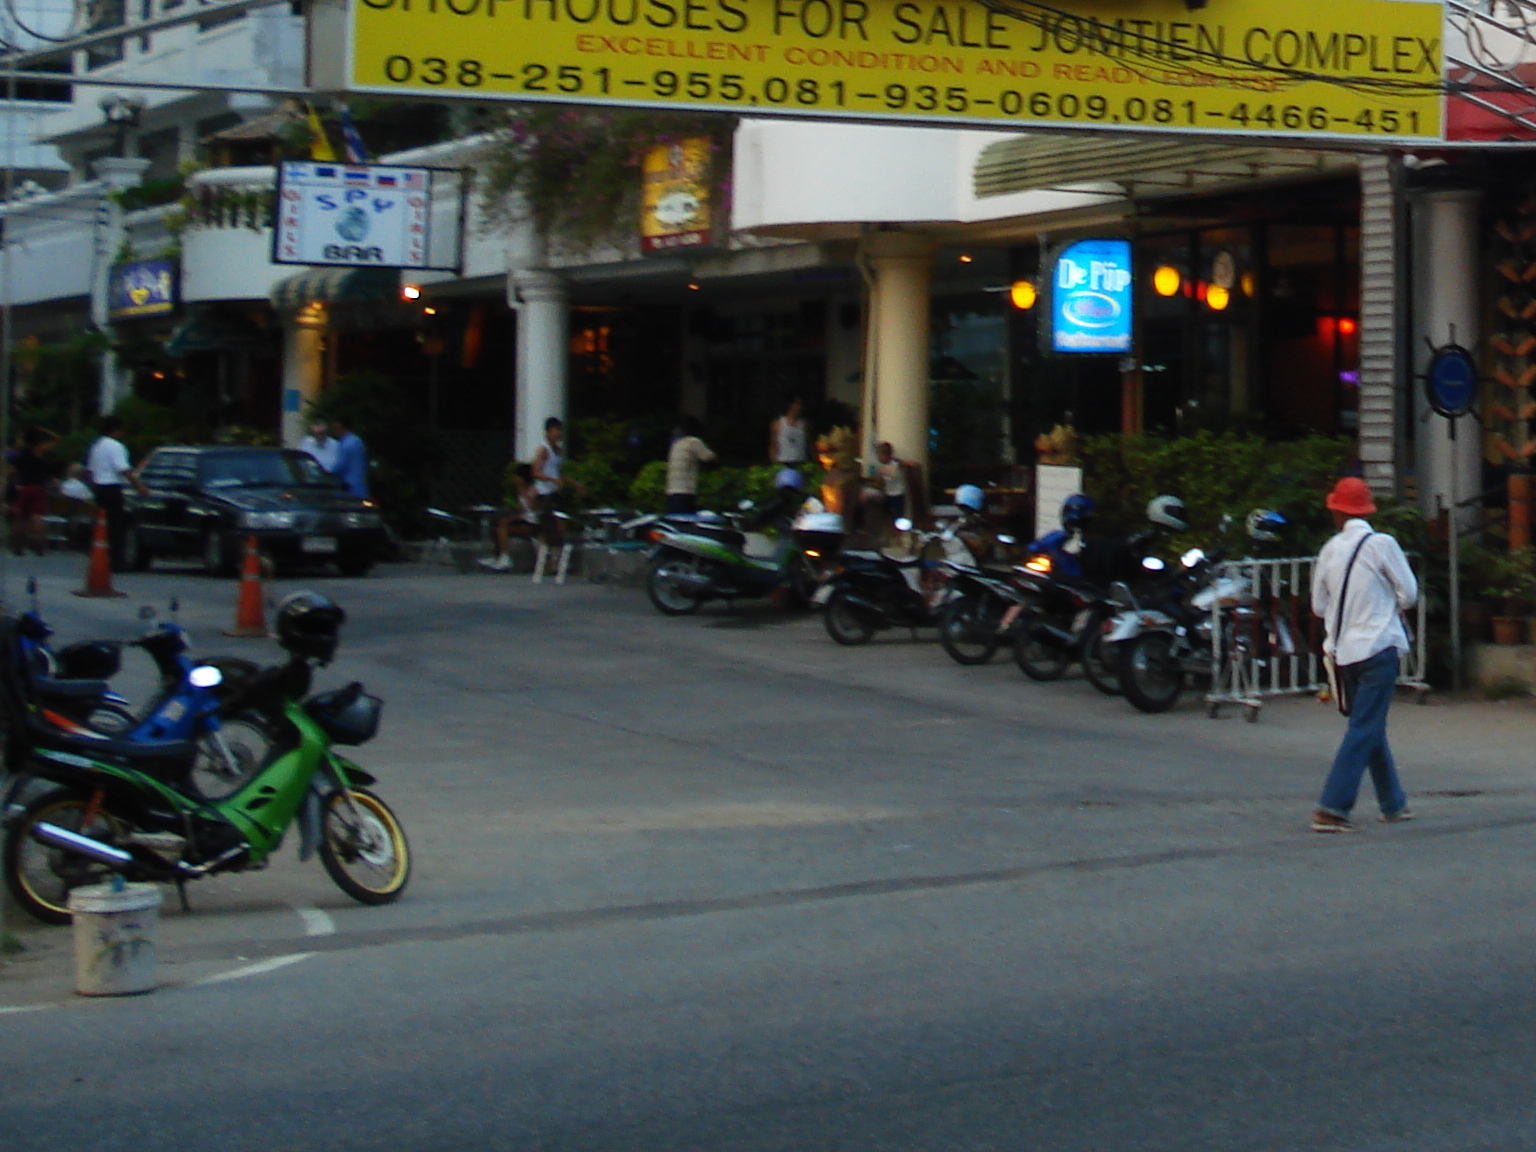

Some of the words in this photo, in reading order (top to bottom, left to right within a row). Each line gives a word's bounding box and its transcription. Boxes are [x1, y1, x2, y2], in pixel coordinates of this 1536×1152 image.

[892, 2, 1010, 51] SALE
[1032, 13, 1226, 66] JOMTIEN
[1243, 28, 1441, 76] COMPLEX
[576, 33, 772, 64] EXCELLENT
[785, 46, 965, 76] CONDITION
[977, 59, 1041, 79] AND
[1053, 63, 1148, 86] READY
[316, 189, 395, 213] SPY
[324, 243, 384, 262] BAR
